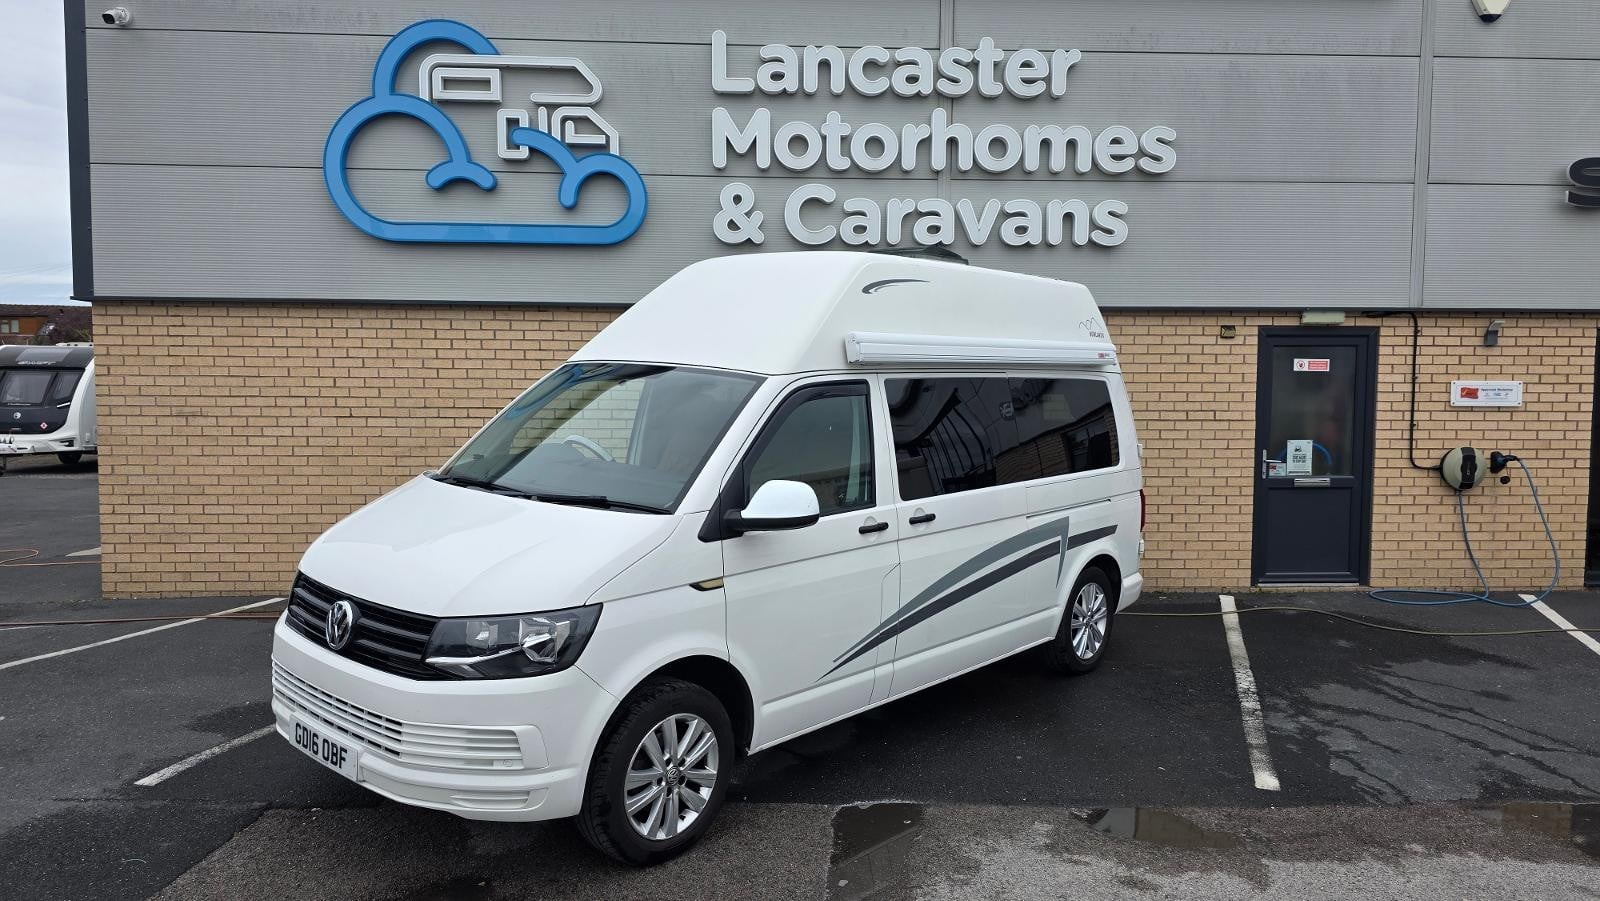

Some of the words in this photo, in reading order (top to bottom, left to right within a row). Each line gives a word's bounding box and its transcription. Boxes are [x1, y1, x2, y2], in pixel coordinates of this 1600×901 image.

[711, 29, 1081, 99] Lancaster
[711, 107, 1177, 175] Motorhomes
[712, 182, 764, 246] &
[784, 183, 1129, 247] Caravans
[295, 722, 319, 756] GD16
[322, 738, 347, 769] OBF
